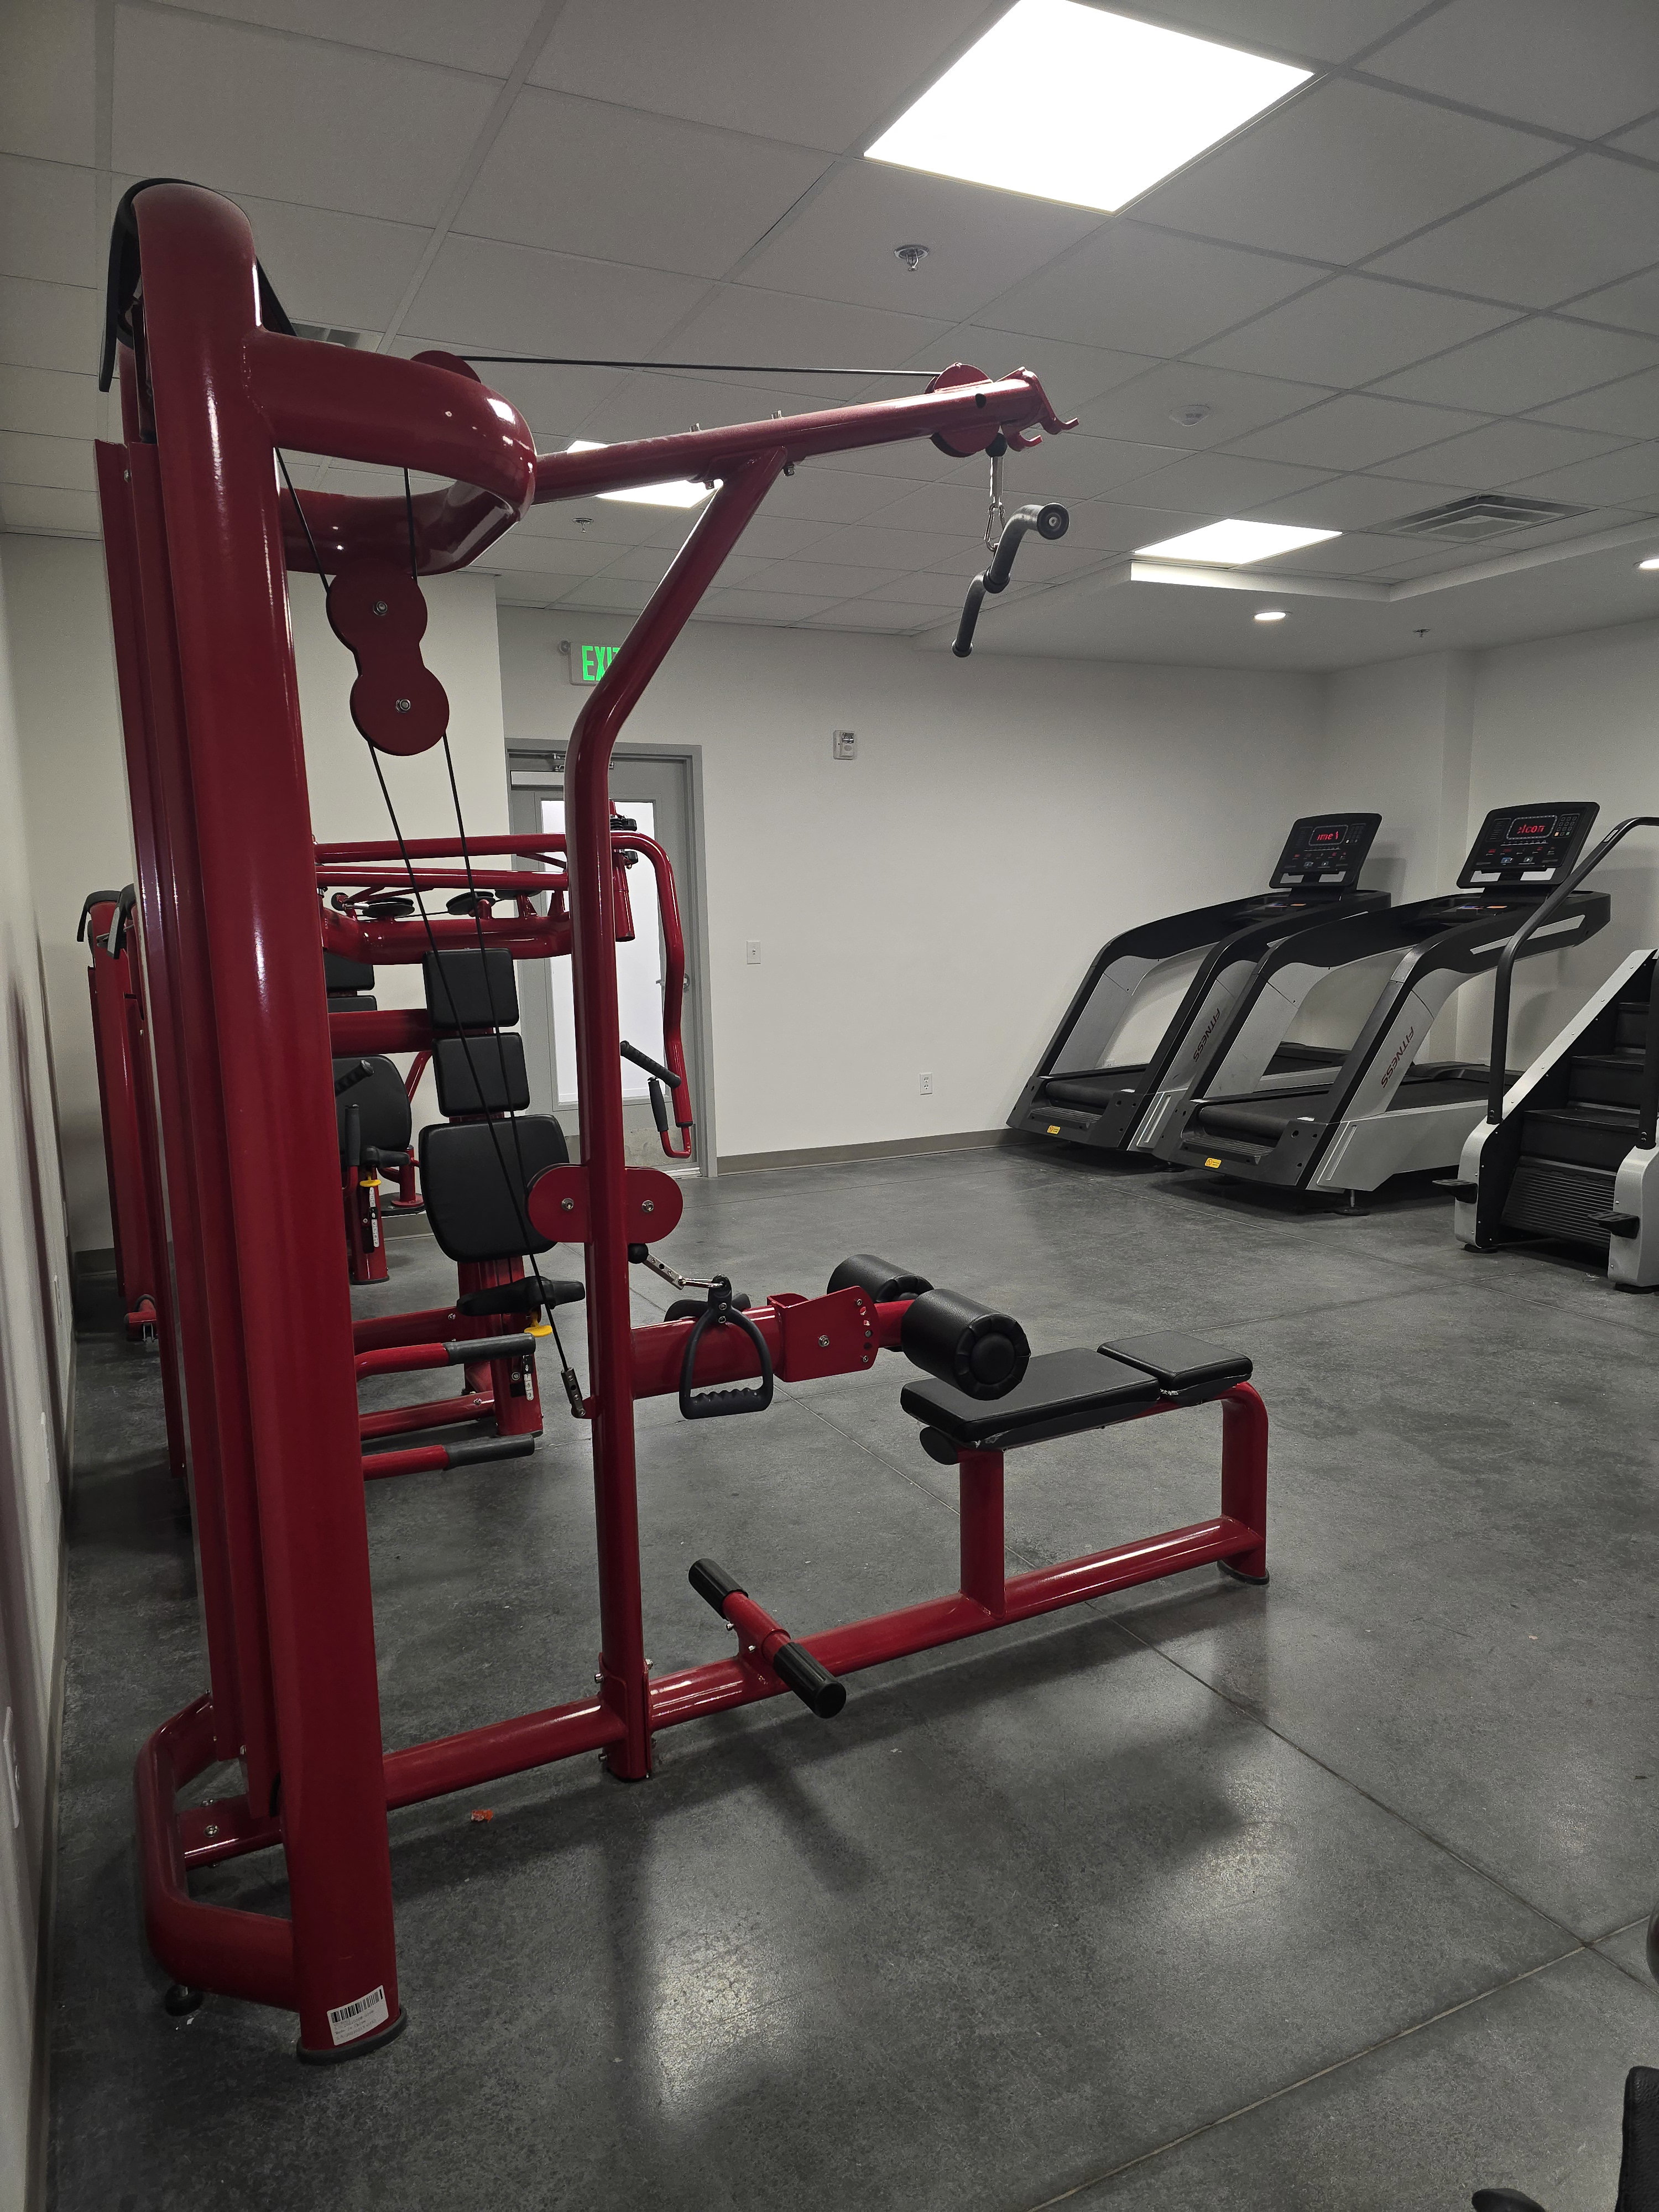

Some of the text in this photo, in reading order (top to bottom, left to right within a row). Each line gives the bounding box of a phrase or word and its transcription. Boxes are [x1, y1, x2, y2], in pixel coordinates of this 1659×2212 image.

[582, 645, 620, 681] EXI
[1193, 1008, 1220, 1062] FITNESS
[1381, 1026, 1414, 1088] FITNESS
